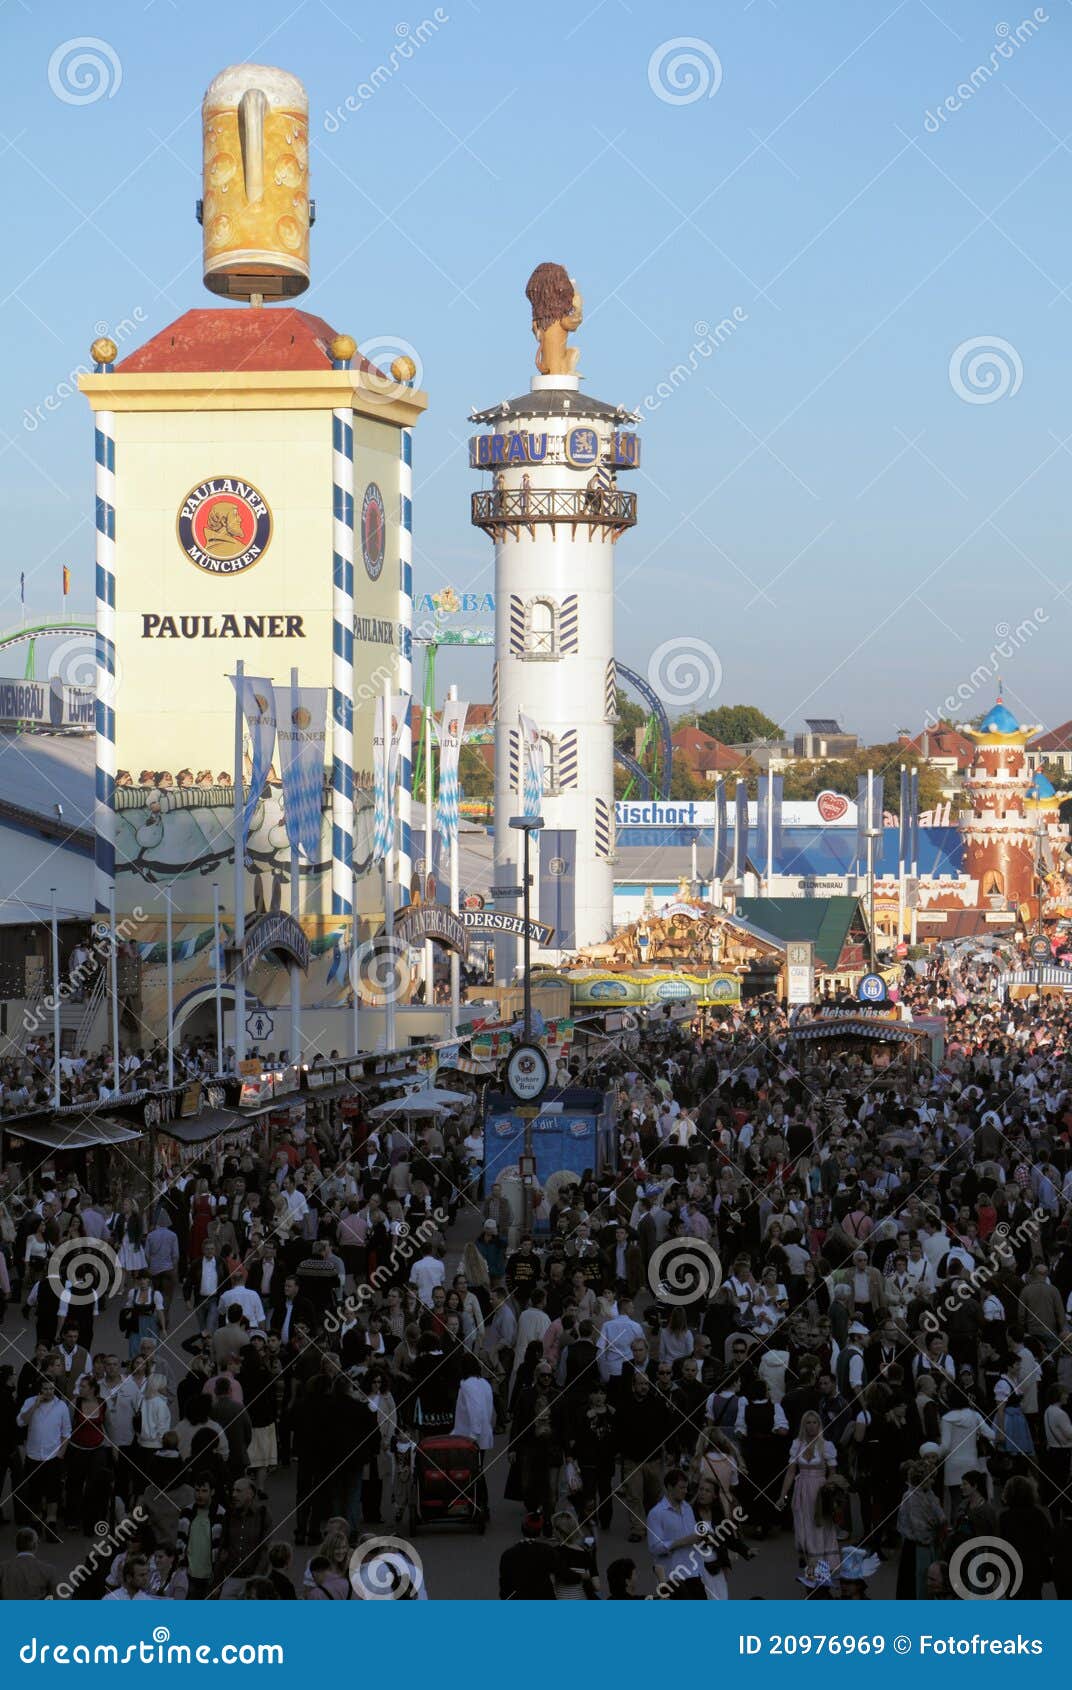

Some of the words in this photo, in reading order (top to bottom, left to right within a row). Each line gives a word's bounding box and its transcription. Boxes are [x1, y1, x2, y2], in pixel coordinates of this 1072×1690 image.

[180, 479, 268, 520] PAULANER
[187, 543, 262, 572] MÜNCHEN
[462, 593, 496, 612] BA
[141, 613, 306, 639] PAULANER
[352, 614, 394, 645] PAULANER
